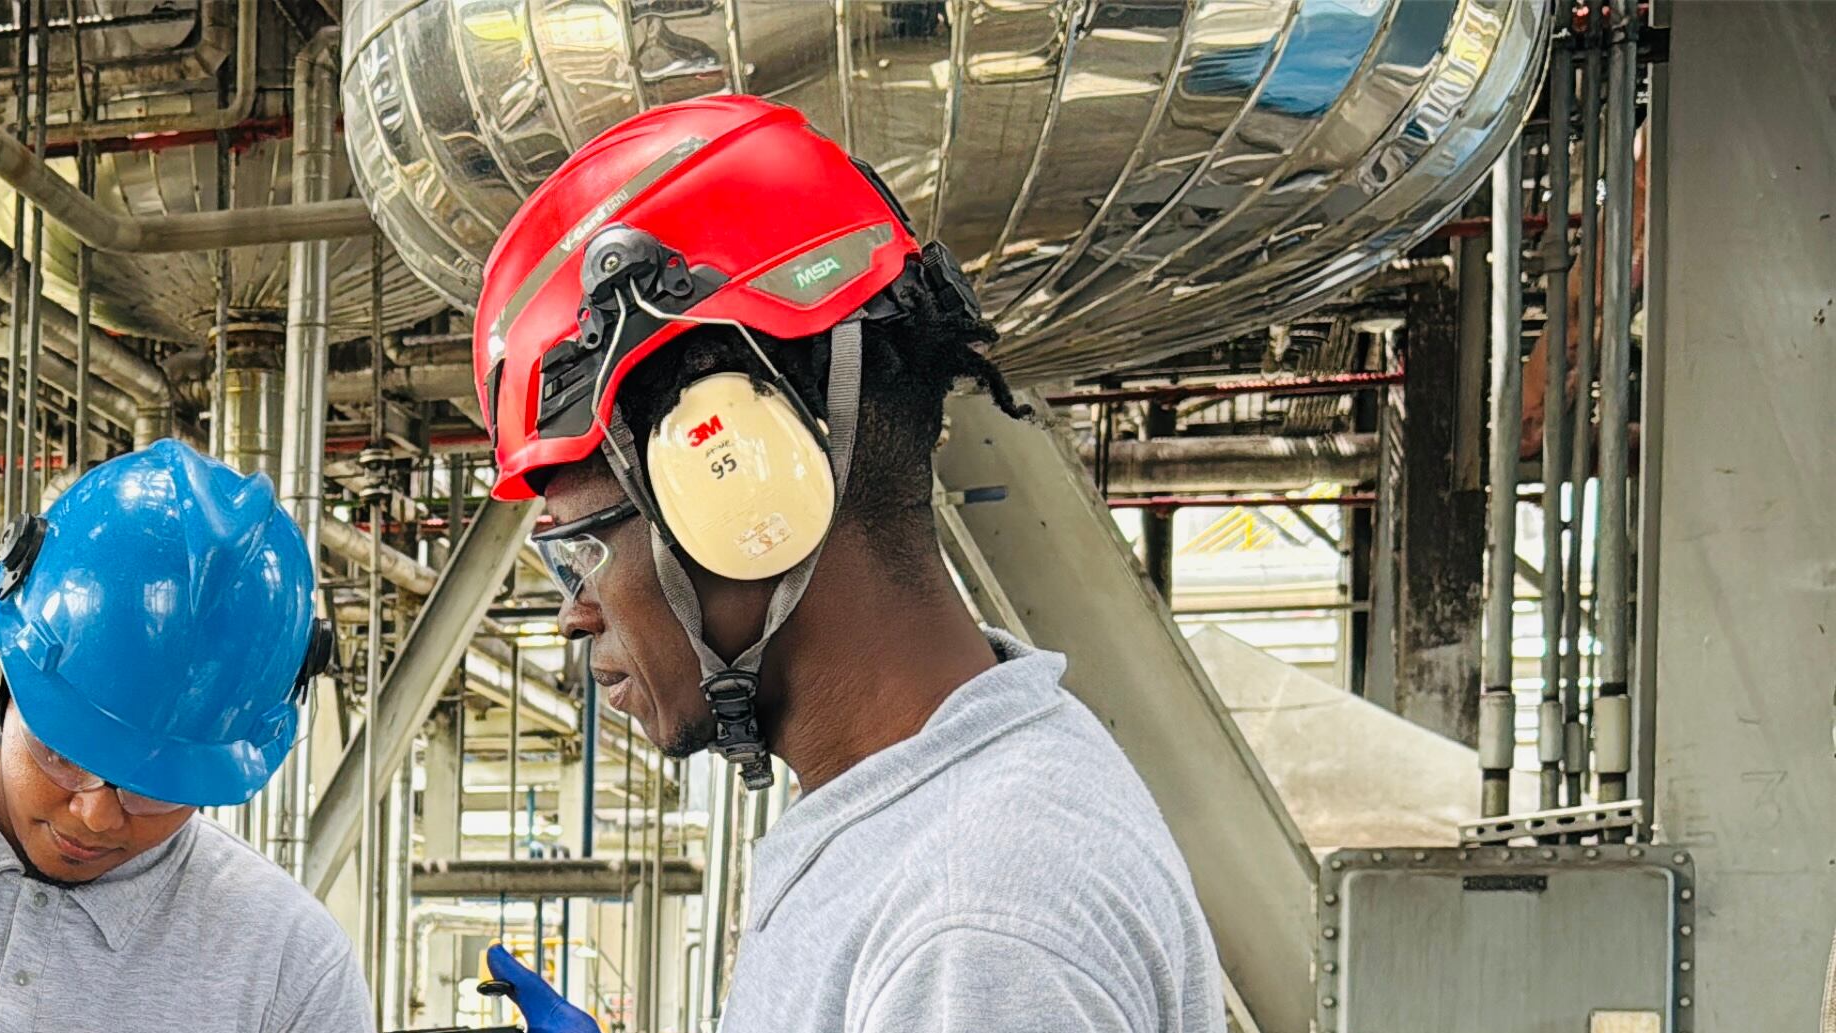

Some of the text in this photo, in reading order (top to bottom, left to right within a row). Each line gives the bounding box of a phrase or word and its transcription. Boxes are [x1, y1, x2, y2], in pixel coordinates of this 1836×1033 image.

[795, 256, 841, 289] MSA
[687, 414, 724, 448] 3M
[710, 452, 738, 480] 95
